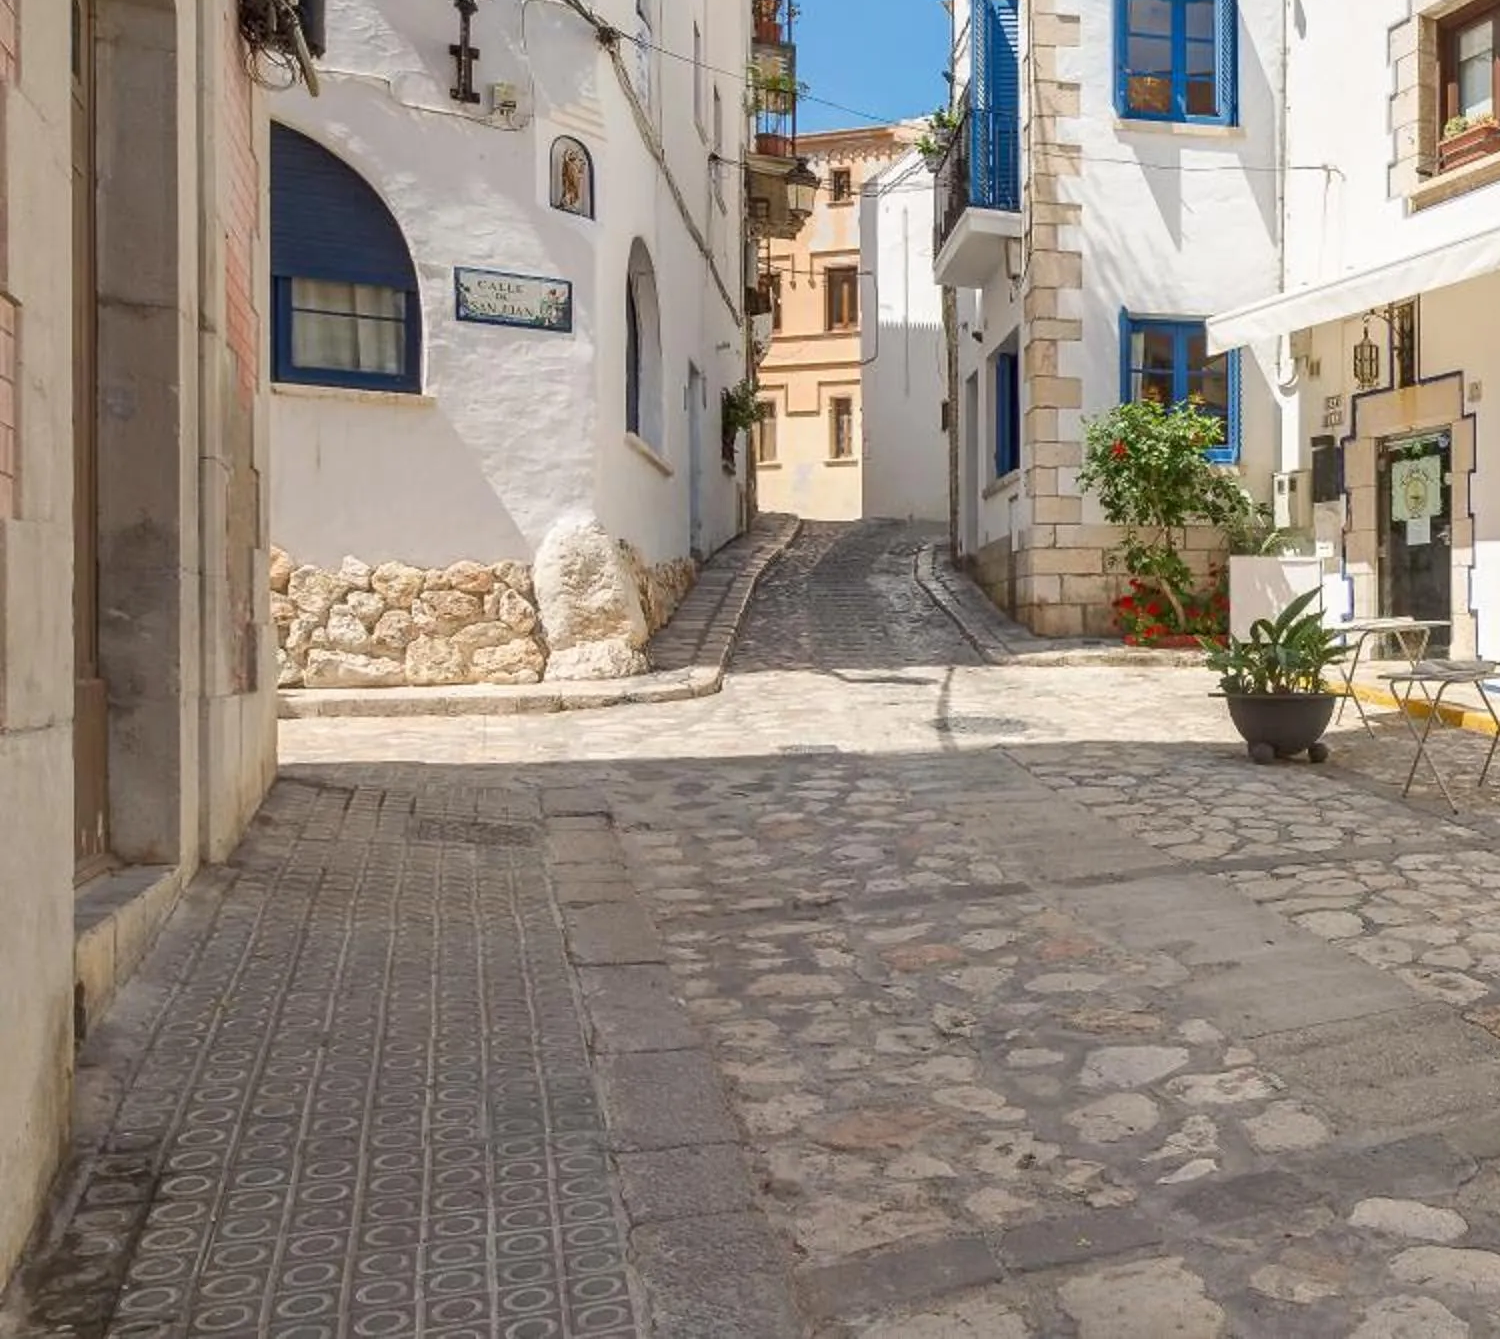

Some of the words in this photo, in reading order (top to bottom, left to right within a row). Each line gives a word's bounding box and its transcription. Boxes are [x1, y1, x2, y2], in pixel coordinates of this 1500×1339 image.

[477, 279, 525, 294] CALLE
[495, 292, 508, 301] DE
[471, 300, 497, 314] SAN
[502, 304, 535, 318] JUAN
